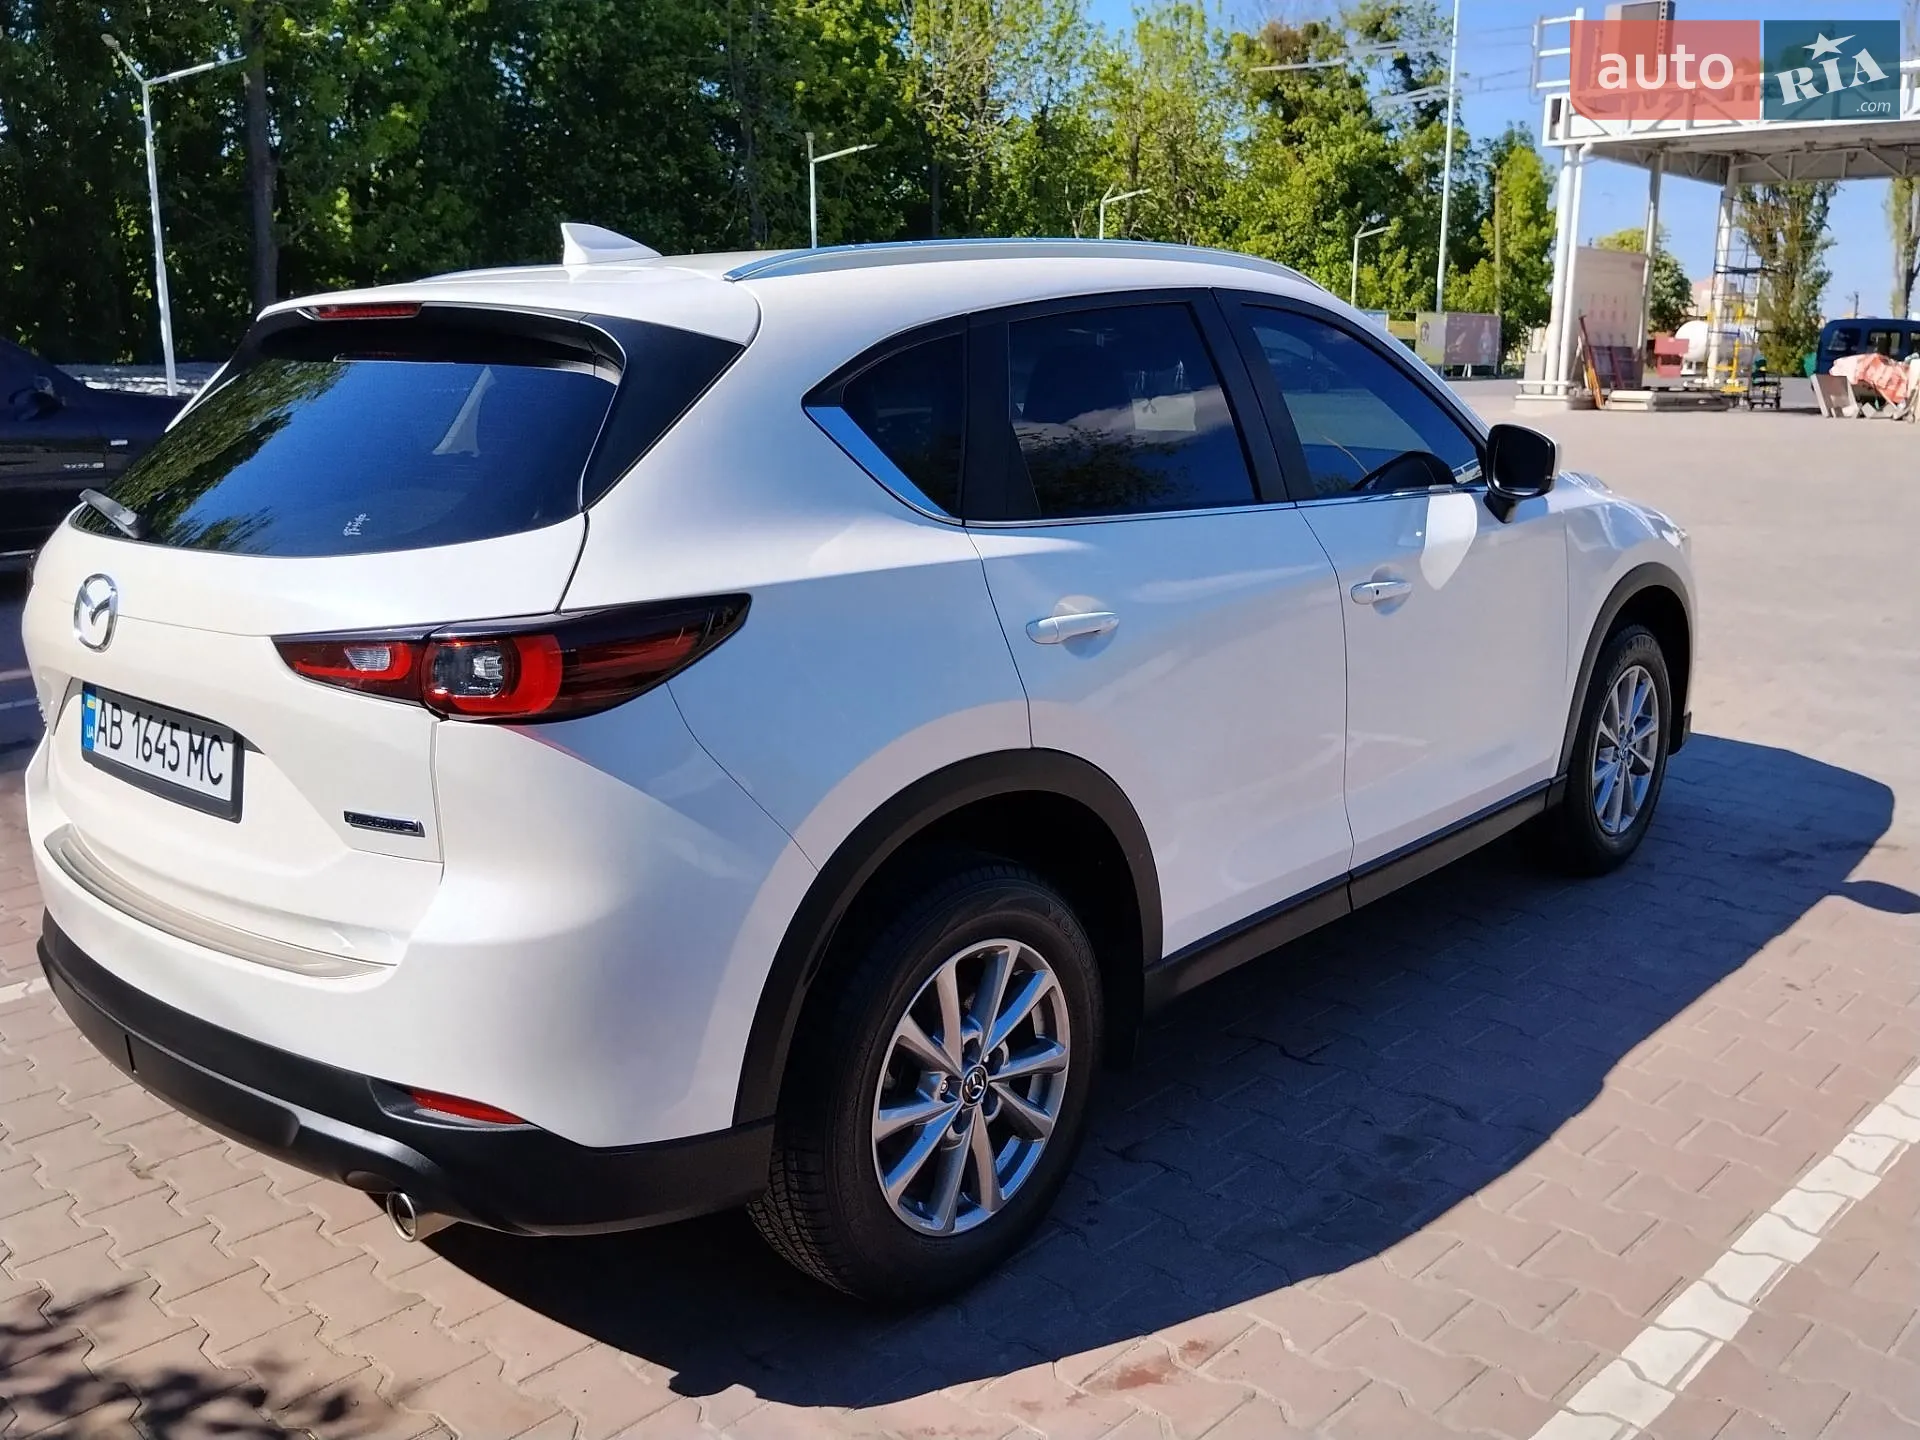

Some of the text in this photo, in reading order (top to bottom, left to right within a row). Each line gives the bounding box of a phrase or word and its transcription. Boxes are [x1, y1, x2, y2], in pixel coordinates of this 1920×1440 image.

[96, 699, 224, 786] AB 1645 MC
